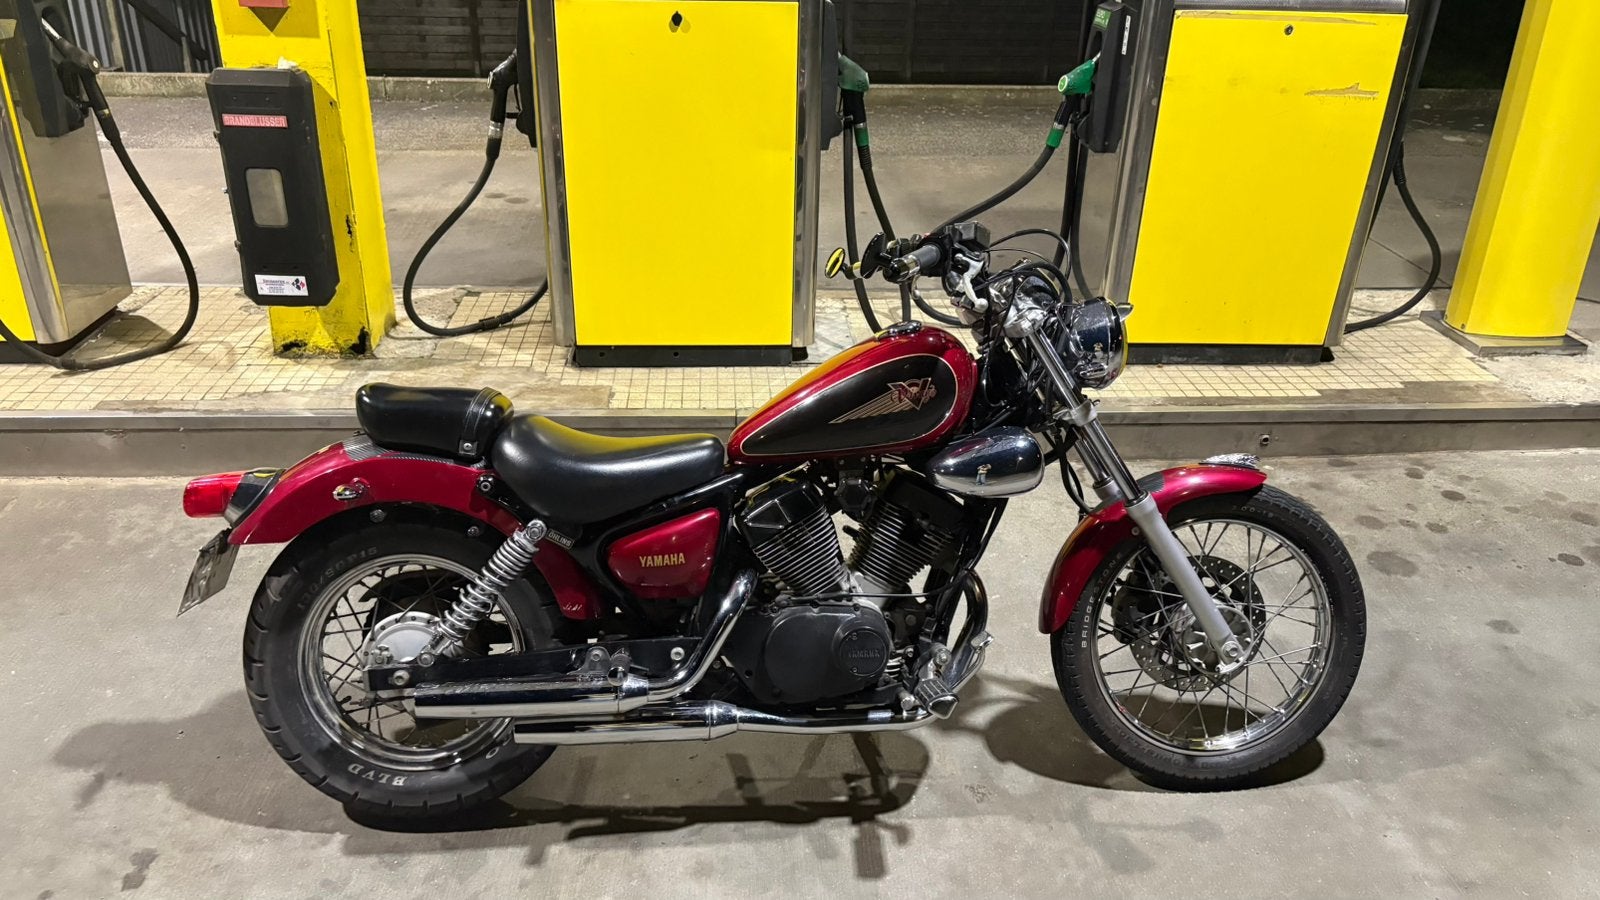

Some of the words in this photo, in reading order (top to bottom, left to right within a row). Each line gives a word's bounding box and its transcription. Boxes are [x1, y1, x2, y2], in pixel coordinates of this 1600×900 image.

[639, 552, 686, 567] YAMAHA
[1081, 551, 1122, 648] BRIDGESTONE
[348, 763, 409, 787] BLVD
